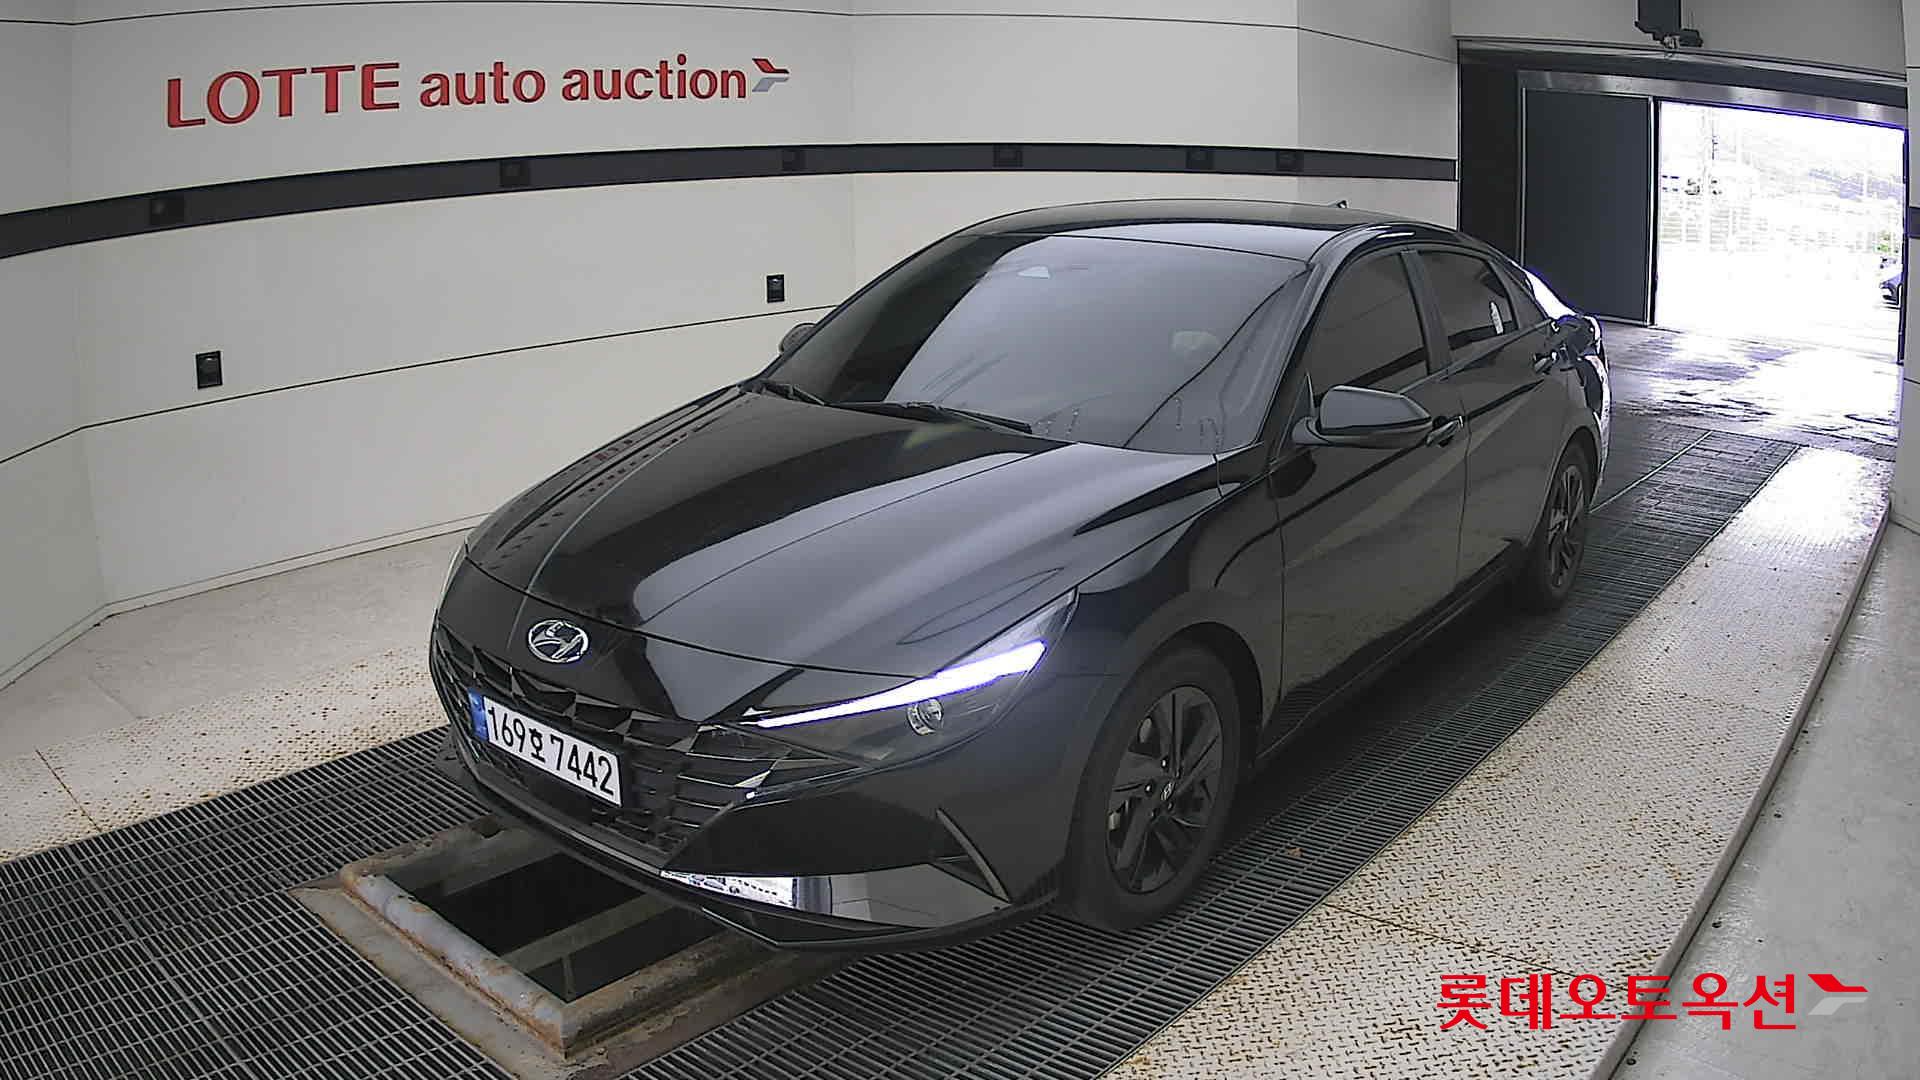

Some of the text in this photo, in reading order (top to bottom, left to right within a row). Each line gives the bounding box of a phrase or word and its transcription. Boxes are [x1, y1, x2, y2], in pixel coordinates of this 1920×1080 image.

[166, 53, 747, 129] LOTTE auto auction
[488, 706, 614, 796] 169호 7442
